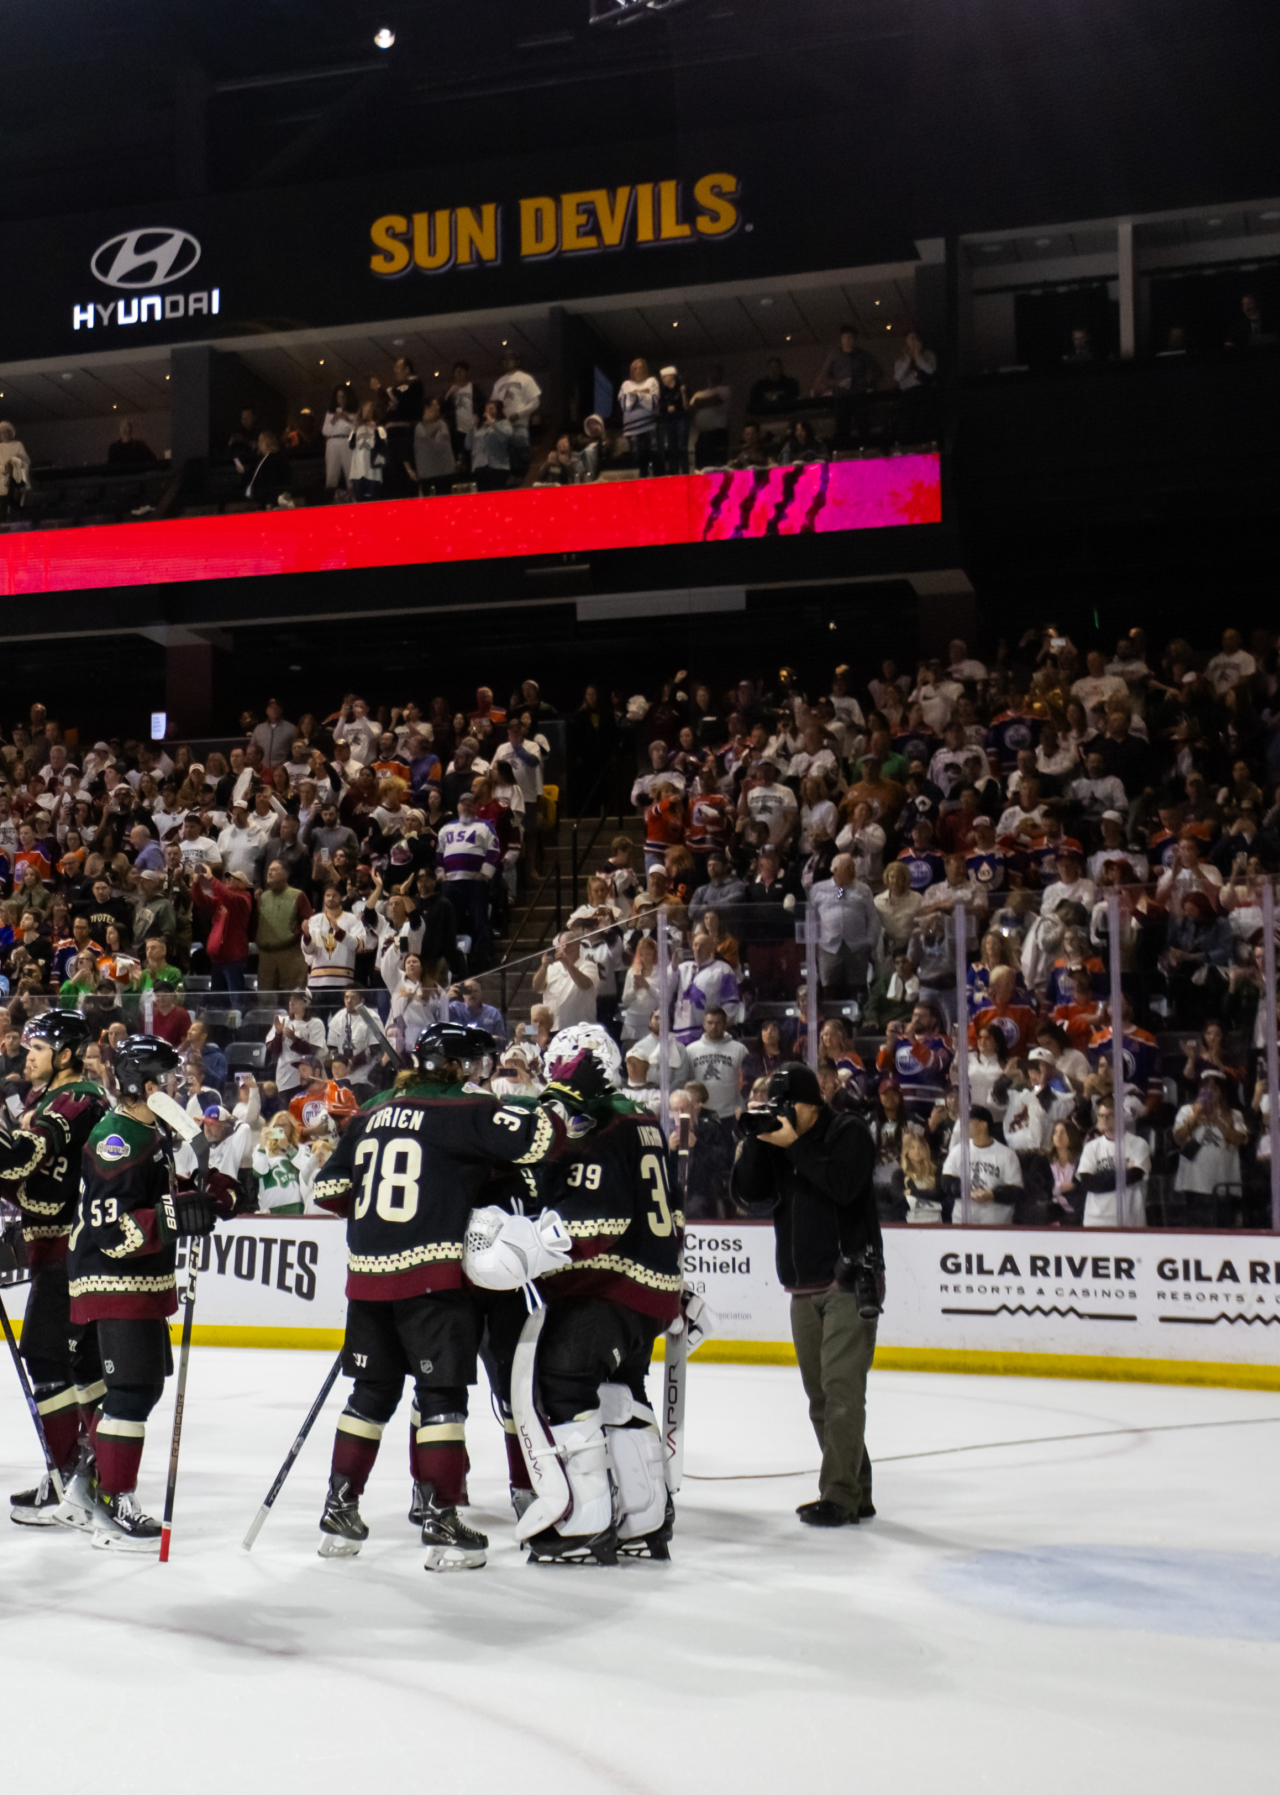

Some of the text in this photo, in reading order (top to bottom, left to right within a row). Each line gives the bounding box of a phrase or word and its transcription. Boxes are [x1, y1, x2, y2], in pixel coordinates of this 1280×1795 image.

[369, 172, 744, 277] SUN DEVILS
[73, 288, 220, 330] HYUNDAI
[446, 830, 477, 844] USA
[354, 1138, 422, 1223] 38
[567, 1163, 602, 1190] 39
[640, 1154, 677, 1238] 3
[91, 1198, 118, 1227] 53
[683, 1233, 743, 1251] Cross
[683, 1256, 751, 1275] Shield
[939, 1253, 1021, 1276] GILA
[1029, 1254, 1136, 1280] RIVER
[1156, 1258, 1241, 1284] GILA
[940, 1284, 1137, 1300] RESORTS & CASINOS
[1157, 1290, 1244, 1303] RESORTS
[171, 1393, 185, 1458] RIBCOR
[666, 1360, 680, 1463] VAPOR
[520, 1421, 543, 1484] VAPOR
